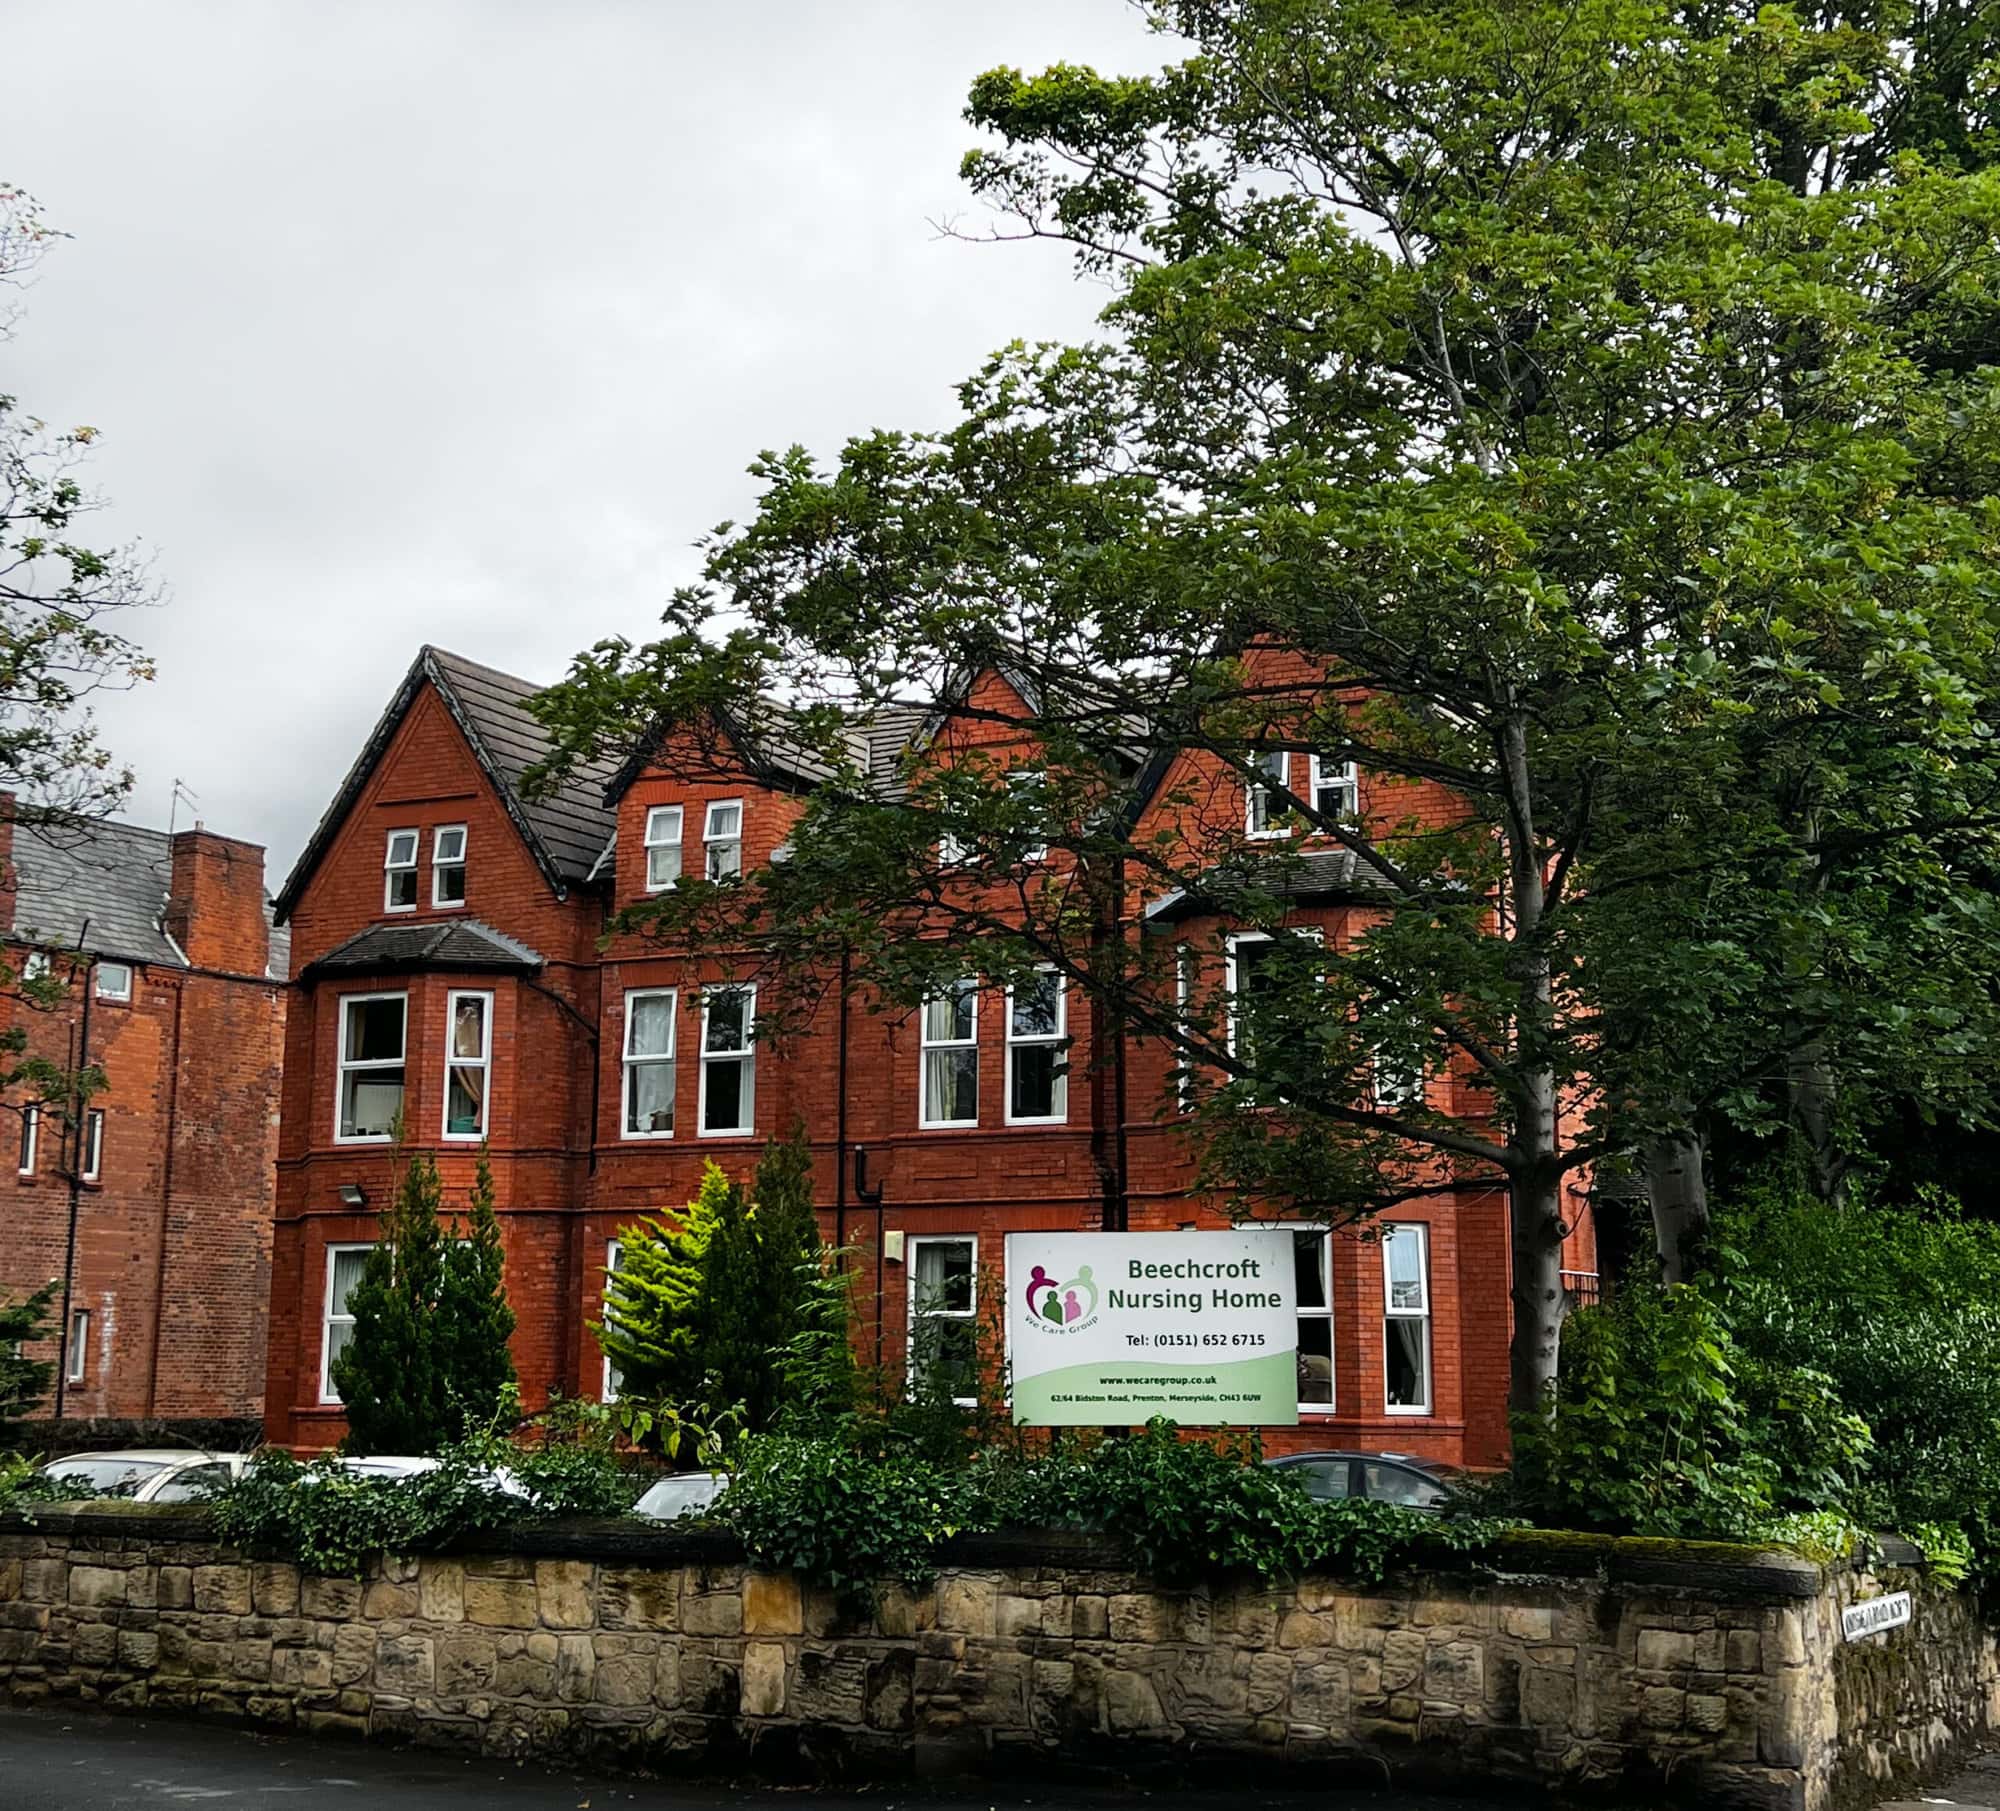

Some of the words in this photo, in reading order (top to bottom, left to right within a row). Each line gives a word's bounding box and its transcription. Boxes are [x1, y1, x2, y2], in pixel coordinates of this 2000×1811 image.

[1128, 1258, 1261, 1279] Beechcroft
[1108, 1289, 1203, 1313] Nursing
[1212, 1289, 1283, 1308] Home
[1024, 1314, 1040, 1329] We
[1041, 1324, 1066, 1335] Care
[1068, 1315, 1099, 1335] Group
[1125, 1334, 1150, 1346] Tel:
[1153, 1334, 1198, 1347] (0151)
[1202, 1334, 1228, 1346] 652
[1231, 1334, 1266, 1346] 6715
[1099, 1375, 1218, 1387] www.wecaregroup.co.uk
[1074, 1394, 1106, 1402] Bidston
[1107, 1394, 1131, 1403] Road,
[1132, 1394, 1168, 1403] Prenton,
[1168, 1393, 1218, 1404] Merseyside,
[1218, 1393, 1241, 1402] CH43
